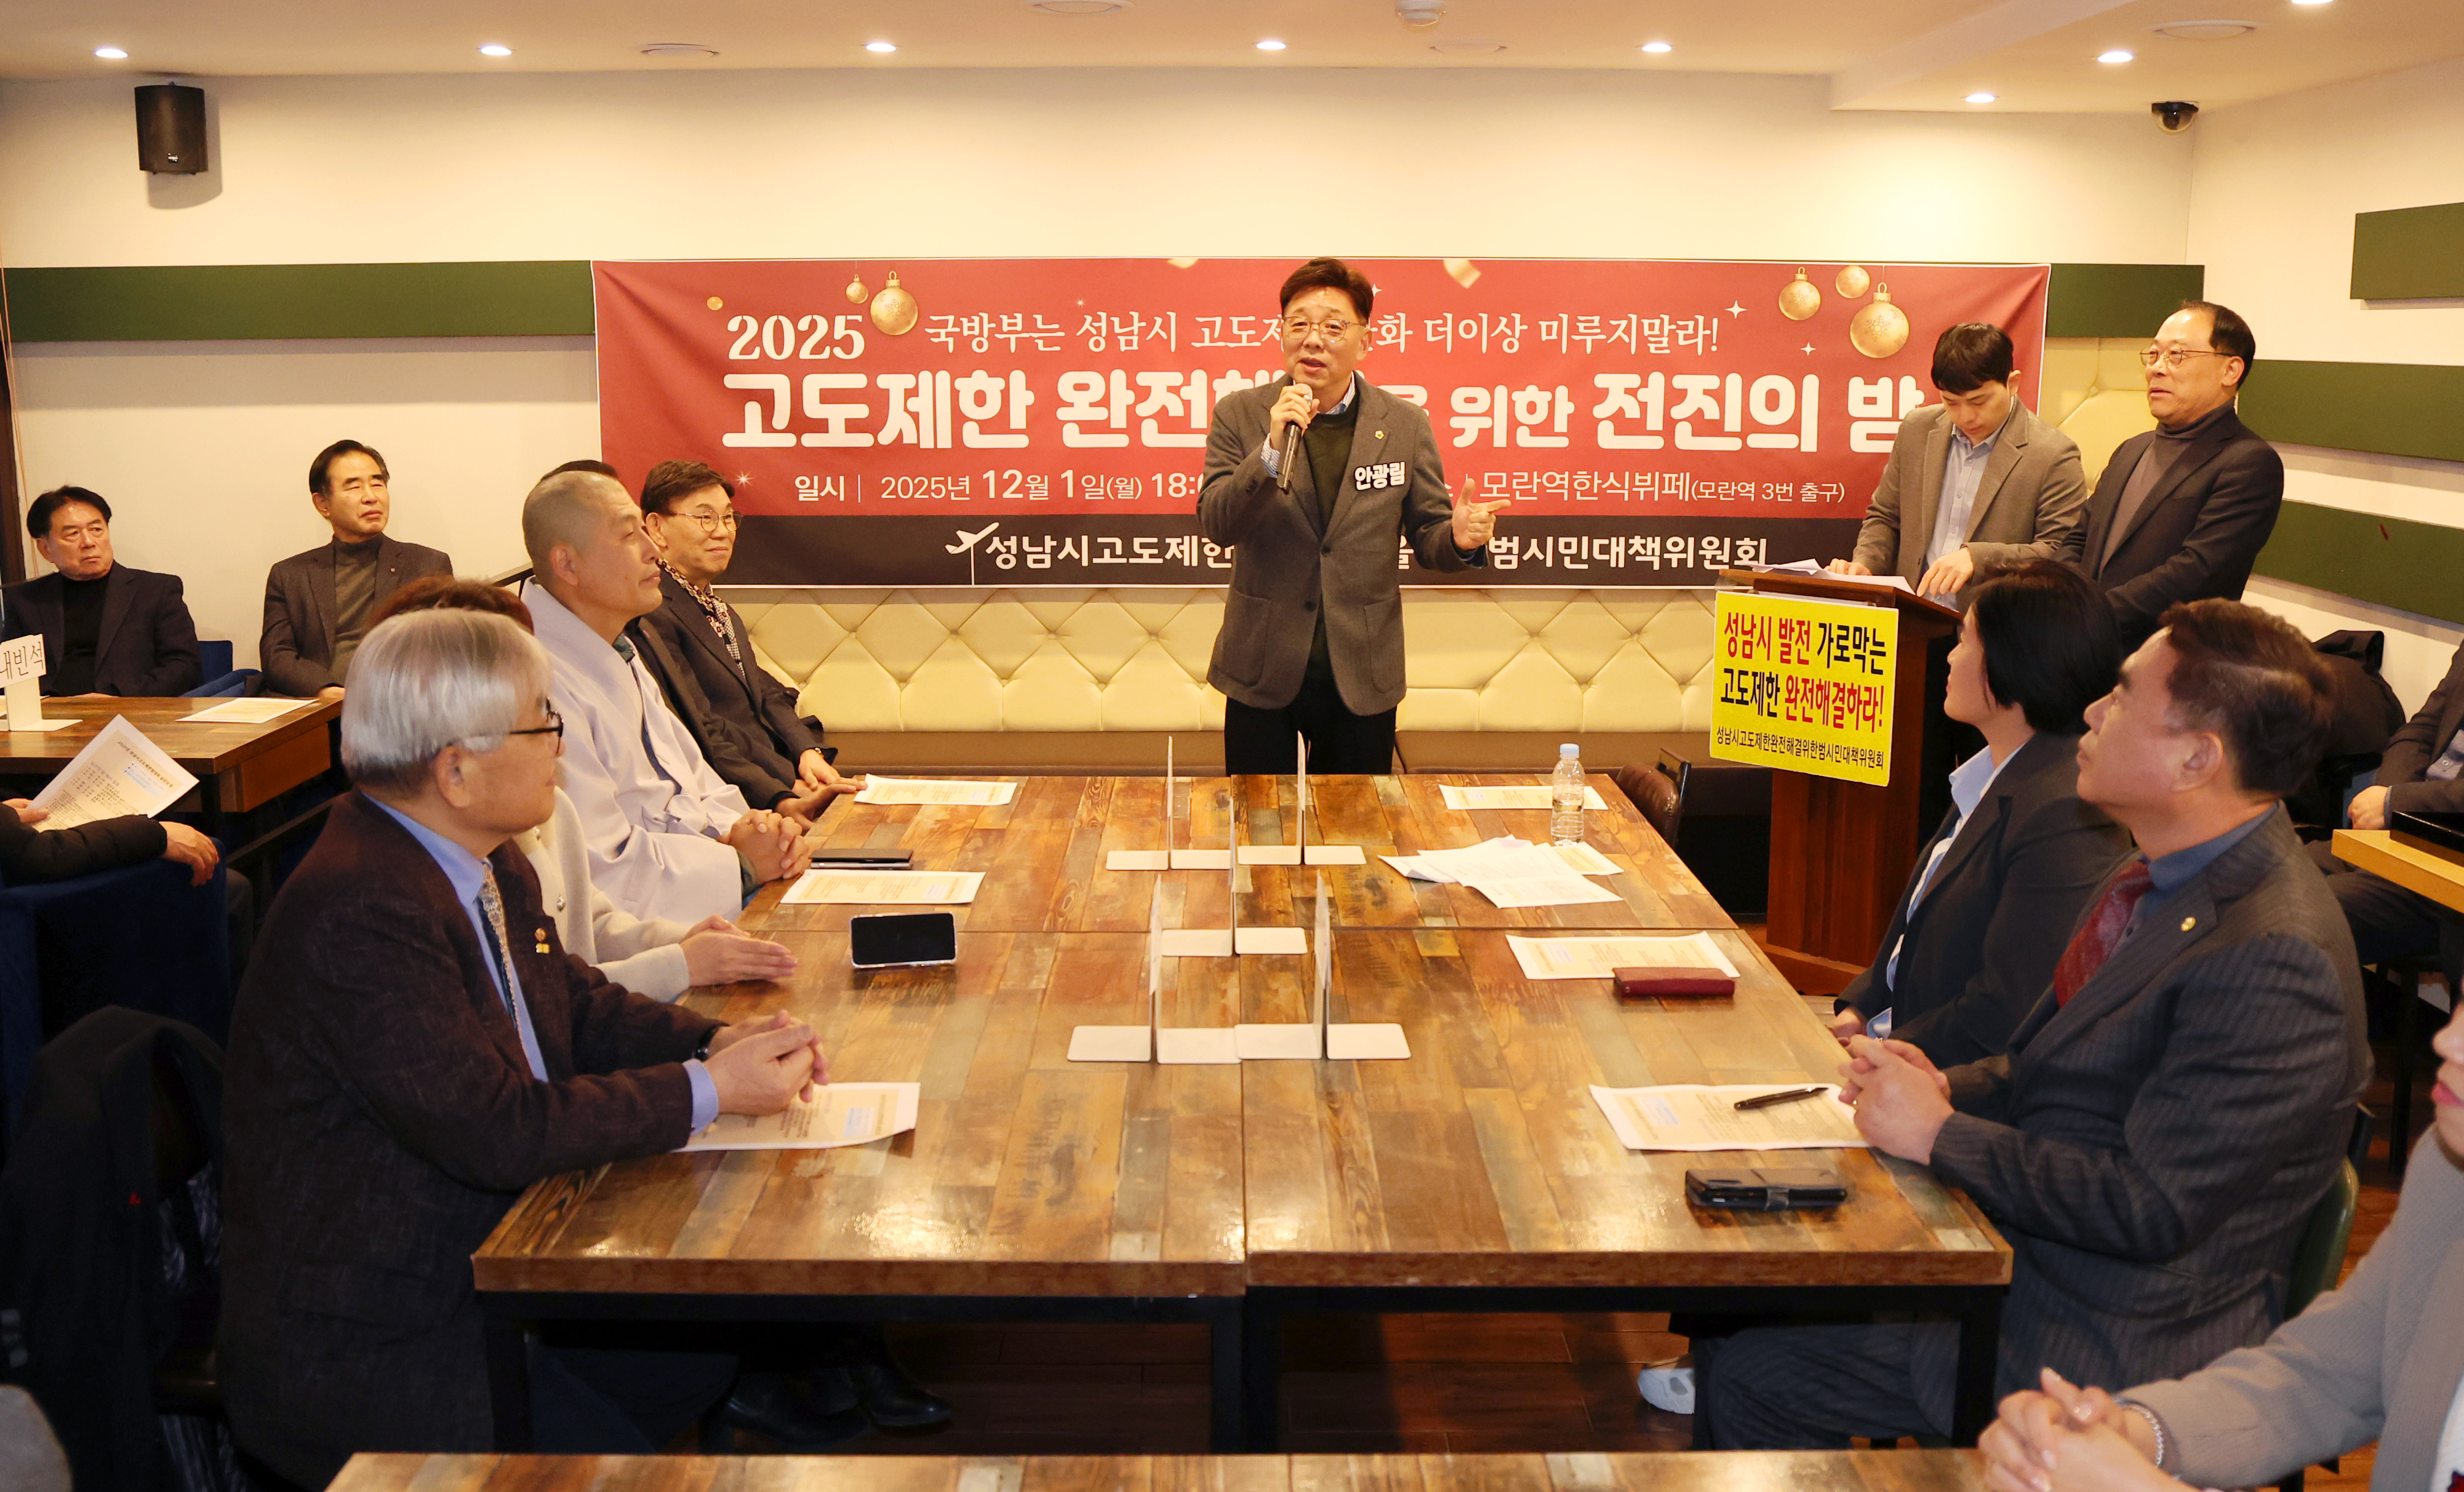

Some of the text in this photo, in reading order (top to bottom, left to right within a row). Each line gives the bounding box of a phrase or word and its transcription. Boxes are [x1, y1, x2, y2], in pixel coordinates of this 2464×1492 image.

[727, 315, 865, 360] 2025
[925, 313, 1065, 353] 국방부는
[1076, 311, 1176, 353] 성남시
[1423, 312, 1528, 354] 더이상
[1540, 313, 1719, 356] 미루지말라!
[722, 369, 1035, 449] 고도제한
[1449, 384, 1575, 448] 위한
[1592, 371, 1820, 453] 전진의
[795, 476, 845, 501] 일시
[881, 476, 971, 501] 2025년
[982, 469, 1049, 501] 12월
[1060, 469, 1143, 500] 1일(월)
[1761, 481, 1796, 501] 3번
[1799, 482, 1845, 503] 출구)
[1354, 462, 1405, 491] 안광림
[1724, 612, 1886, 676] 성남시 발전 가로막는
[1720, 668, 1885, 733] 고도제한 완전해결하라!
